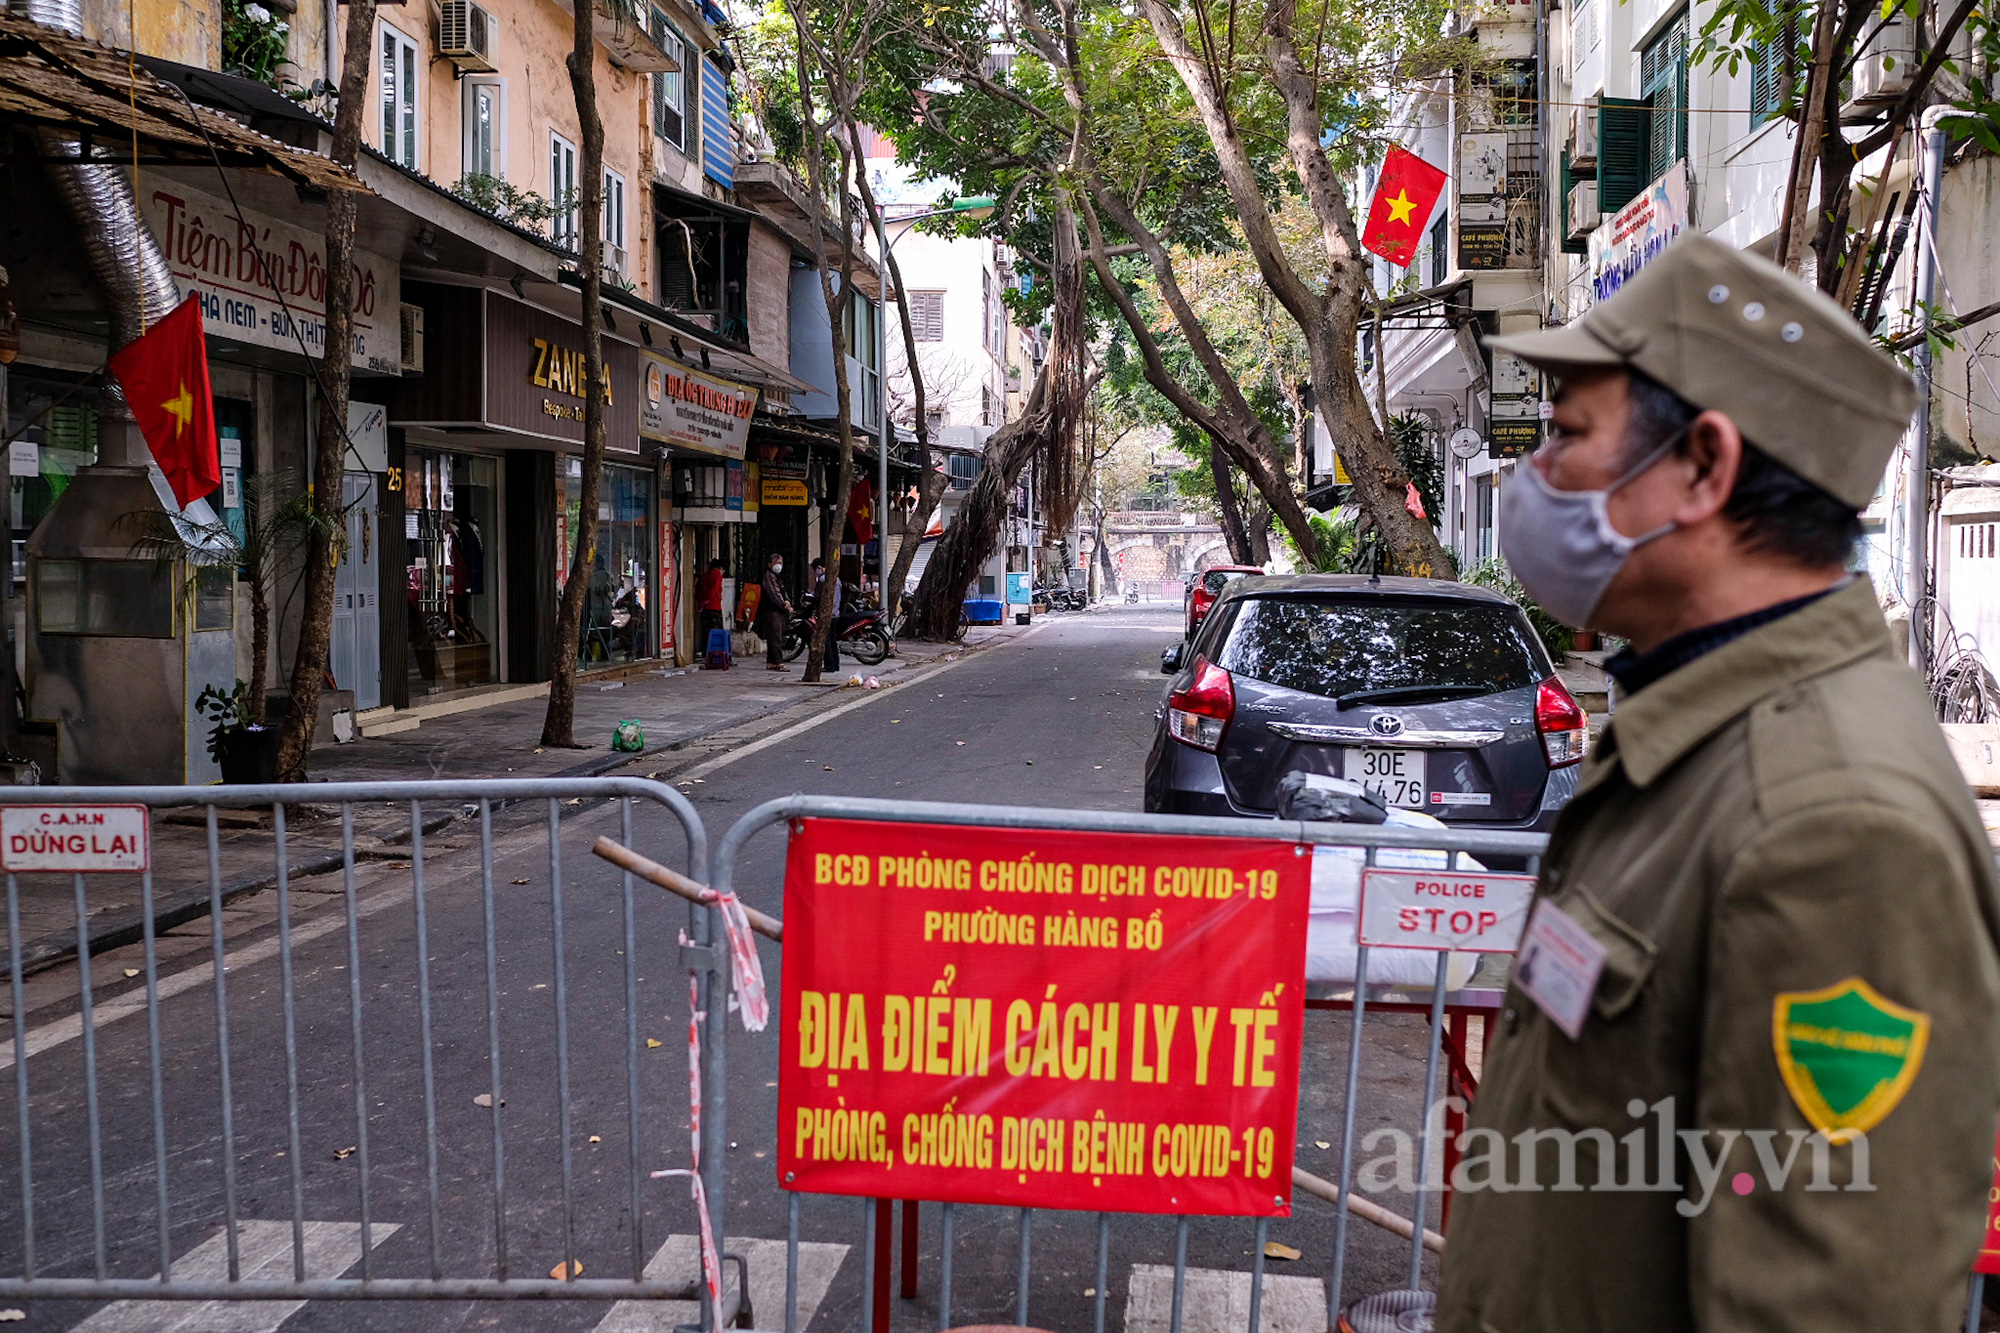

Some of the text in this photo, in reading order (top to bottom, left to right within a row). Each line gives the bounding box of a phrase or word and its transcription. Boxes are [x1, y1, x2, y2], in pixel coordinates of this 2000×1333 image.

[153, 191, 230, 279] Tiệm
[224, 214, 287, 293] Bún
[225, 301, 256, 329] NEM
[533, 337, 613, 406] ZANEA
[543, 398, 571, 421] Bespoke
[698, 385, 727, 413] TRUNG
[387, 466, 402, 492] 25
[1363, 752, 1405, 777] 30E
[40, 813, 105, 825] C.A.H.N
[10, 828, 136, 858] DỪNG LẠI
[815, 852, 1278, 901] BCĐ PHÒNG CHỐNG DỊCH COVID-19
[1415, 881, 1486, 898] POLICE
[924, 907, 1163, 951] PHƯỜNG HÀNG BỒ
[1399, 908, 1498, 935] STOP
[798, 964, 1285, 1088] ĐỊA ĐIỂM CÁCH LY Y TẾ
[795, 1096, 1275, 1187] PHÒNG, CHỐNG DỊCH BỆNH COVID-19
